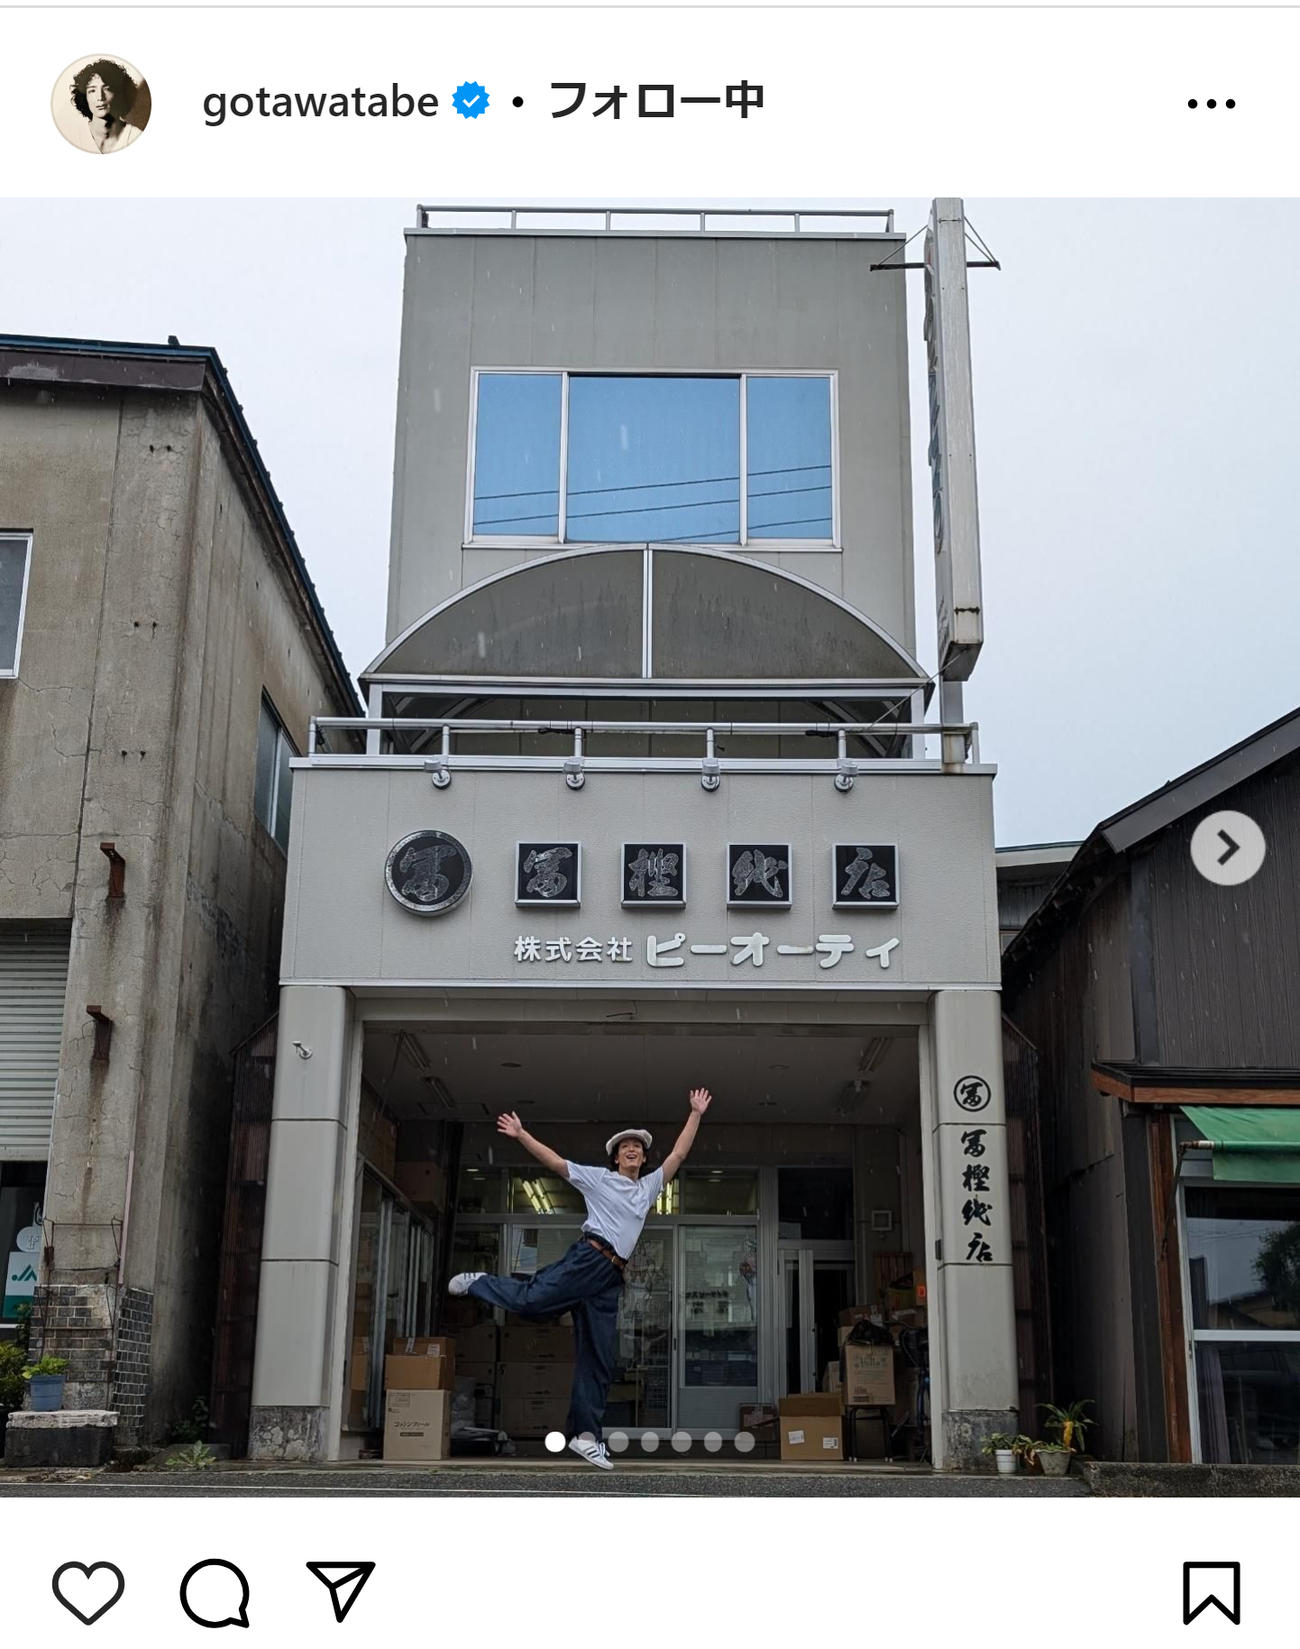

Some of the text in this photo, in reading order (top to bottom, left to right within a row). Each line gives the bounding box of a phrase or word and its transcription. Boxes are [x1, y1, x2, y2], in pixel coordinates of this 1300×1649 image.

[513, 931, 900, 968] 株式会社 ピーオーティ
